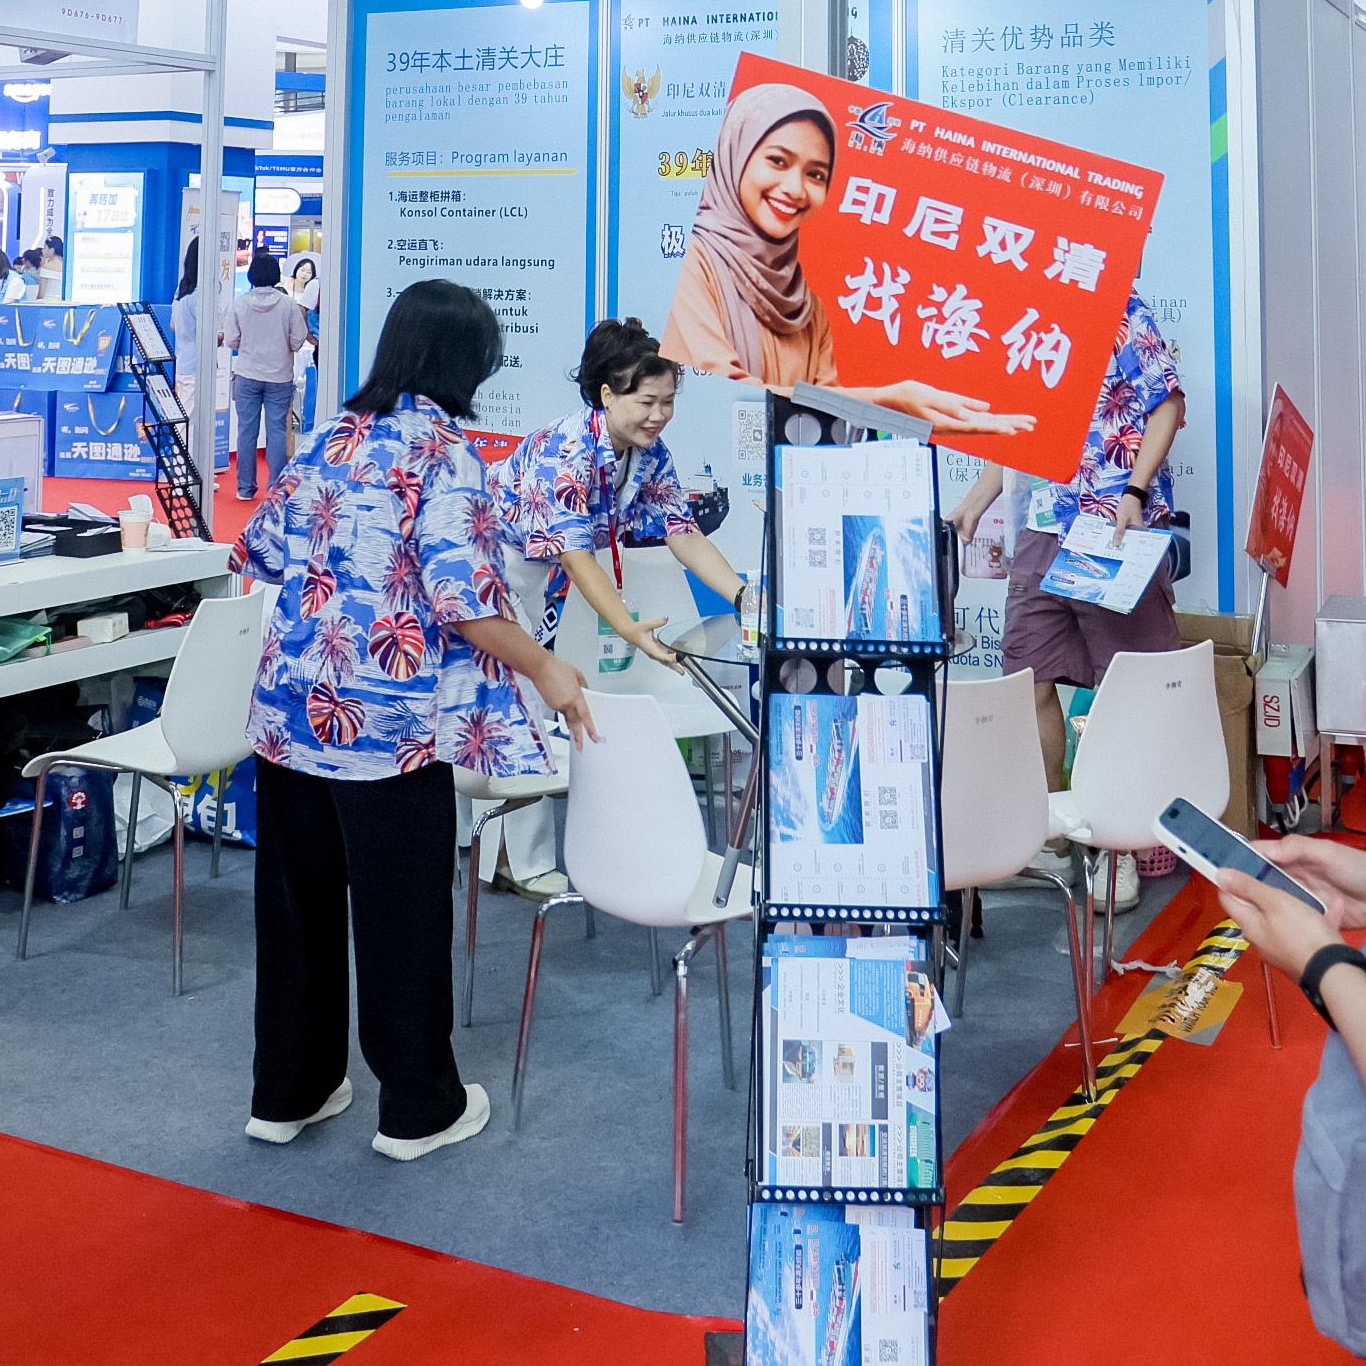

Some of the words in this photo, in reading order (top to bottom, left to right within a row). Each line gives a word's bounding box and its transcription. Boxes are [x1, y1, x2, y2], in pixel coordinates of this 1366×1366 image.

[61, 8, 124, 24] 9D676-9D677
[638, 17, 650, 29] PT
[662, 15, 698, 27] HAINA
[942, 21, 1116, 54] 清关优势品类
[386, 44, 565, 73] 39年本土清关大庄
[942, 62, 1010, 79] Kategori
[1017, 61, 1069, 76] Barang
[1077, 60, 1112, 75] yang
[1118, 55, 1192, 72] Memiliki
[386, 82, 451, 97] perusahaan
[458, 81, 492, 93] besar
[498, 78, 568, 93] pembebasan
[942, 78, 1019, 94] Kelebihan
[1026, 76, 1070, 91] dalam
[1077, 75, 1130, 89] Proses
[386, 97, 424, 110] barang
[431, 96, 461, 108] lokal
[468, 94, 508, 107] dengan
[514, 93, 528, 105] 39
[535, 92, 568, 104] tahun
[942, 94, 993, 111] Ekspor
[1002, 89, 1095, 108] (Clearance)
[386, 110, 451, 124] pengalaman
[452, 151, 509, 167] Program
[514, 150, 568, 166] layanan
[910, 120, 926, 132] PT
[934, 127, 976, 148] HAINA
[982, 140, 1081, 179] INTERNATIONAL
[1087, 170, 1145, 199] TRADING
[400, 207, 437, 218] Konsol
[441, 207, 496, 218] Container
[499, 207, 528, 219] (LCL)
[838, 176, 1106, 292] 印尼双清
[399, 256, 463, 270] Pengiriman
[466, 256, 498, 267] udara
[501, 256, 555, 270] langsung
[494, 306, 528, 317] untuk
[837, 256, 1073, 388] 找海纳
[488, 390, 521, 402] dekat
[501, 416, 521, 427] dan
